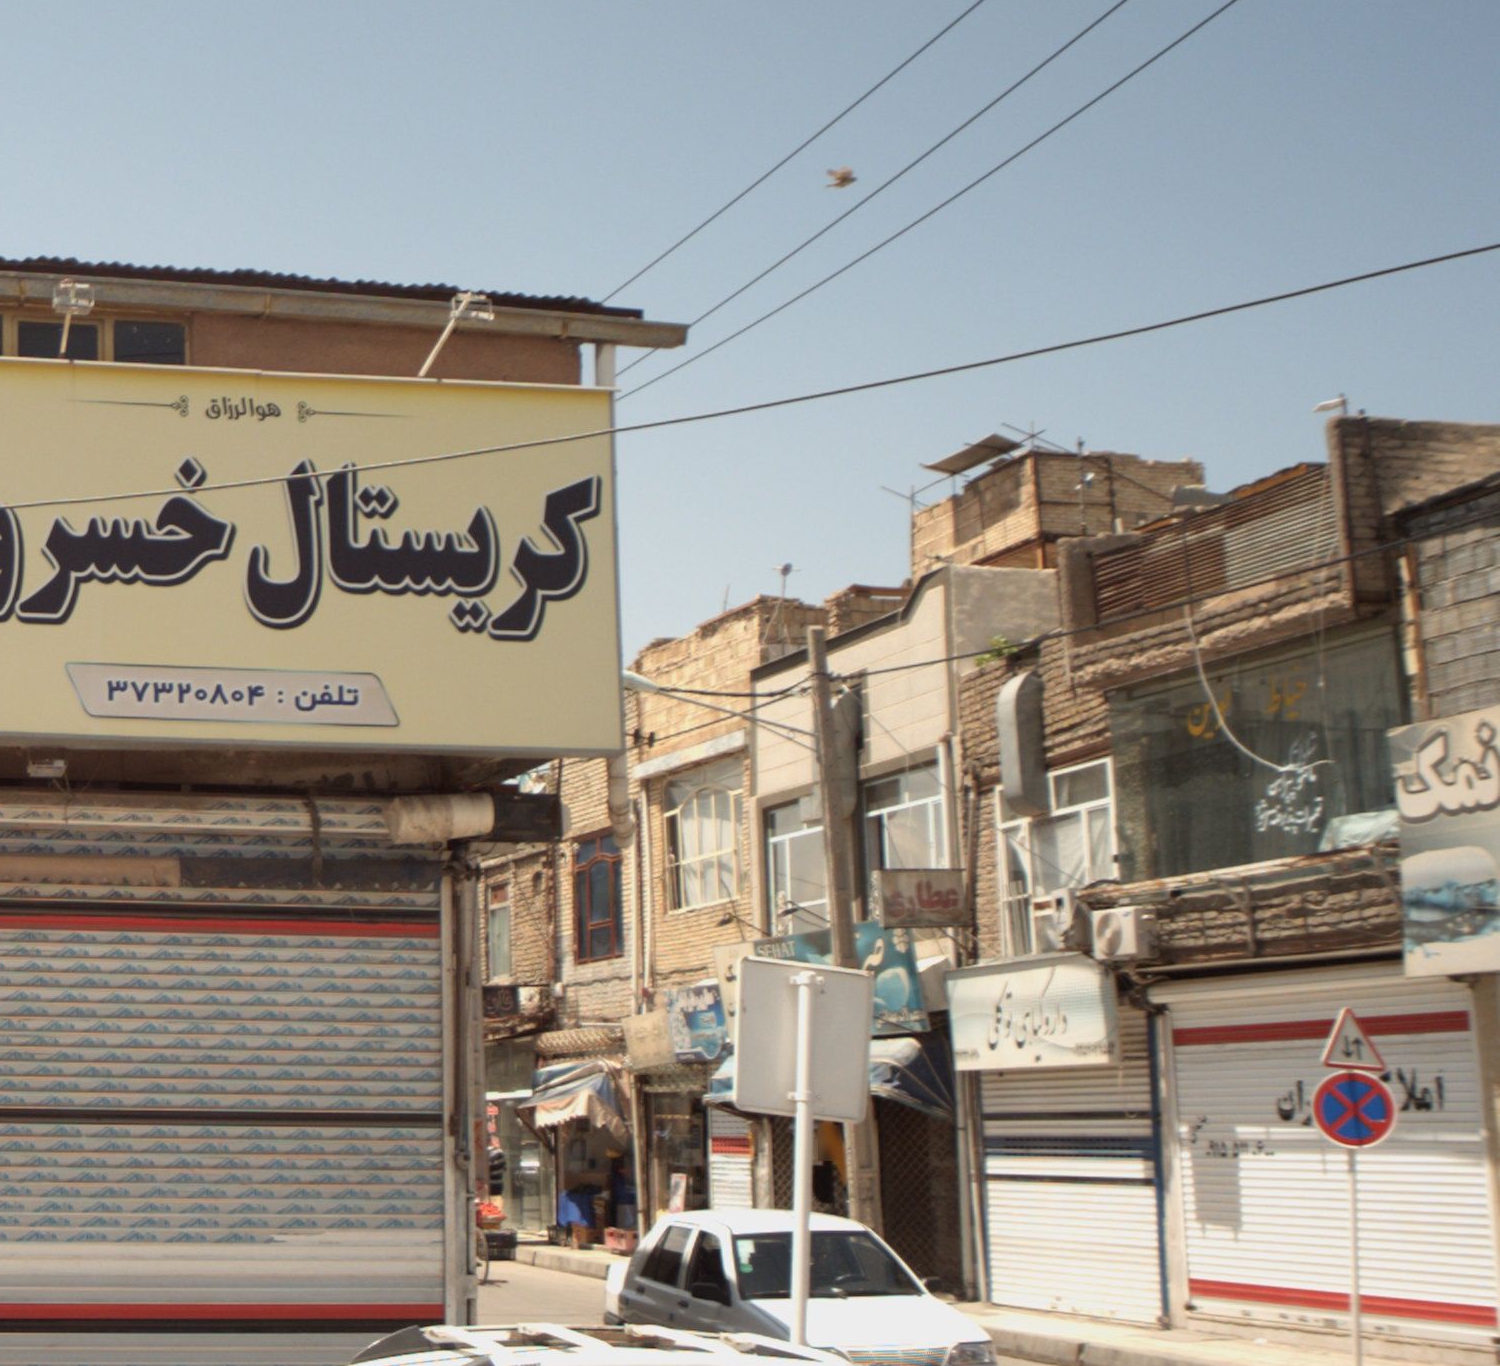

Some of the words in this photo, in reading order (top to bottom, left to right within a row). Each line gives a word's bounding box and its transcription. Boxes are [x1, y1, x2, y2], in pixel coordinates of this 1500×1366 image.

[244, 457, 602, 640] کریستال
[106, 679, 266, 707] ۳۷۳۲۰۸۰۴
[293, 683, 360, 714] تلفن
